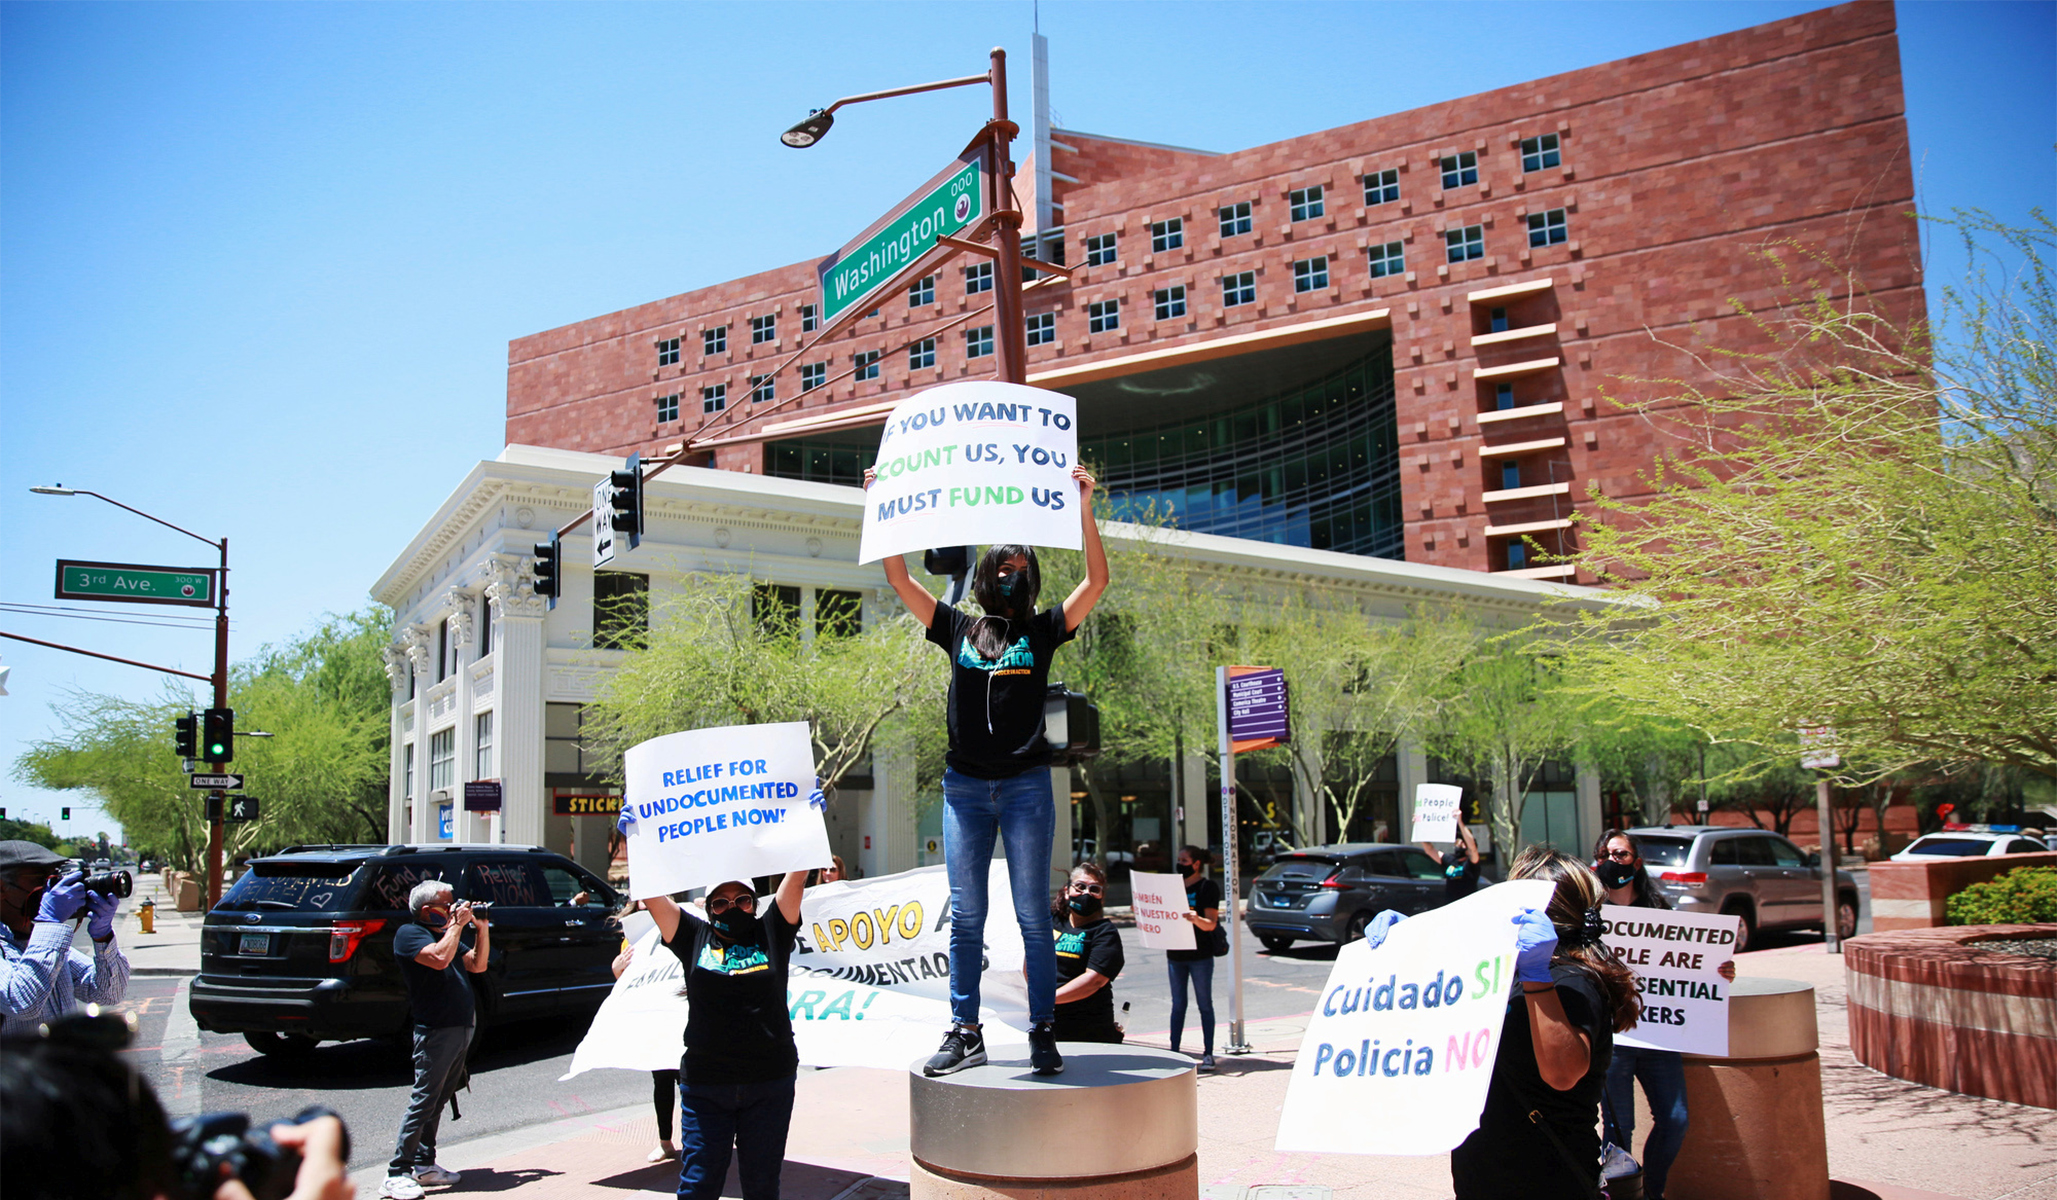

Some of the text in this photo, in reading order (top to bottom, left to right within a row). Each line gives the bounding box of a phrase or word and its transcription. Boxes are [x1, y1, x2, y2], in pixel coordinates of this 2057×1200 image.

[951, 172, 972, 196] 000
[835, 207, 945, 300] Washington
[900, 407, 946, 434] YOU
[953, 402, 1032, 422] WANT
[1038, 407, 1071, 431] TO
[876, 443, 1067, 481] COUNT US, YOU
[597, 483, 612, 511] ONE
[877, 486, 1065, 522] MUST FUND US
[597, 508, 612, 535] WAY
[79, 573, 156, 591] 3rd Ave.
[175, 576, 193, 584] 300
[1251, 688, 1263, 696] Court
[195, 777, 229, 785] ONE WAY
[663, 759, 768, 788] RELIEF FOR
[639, 781, 799, 819] UNDOCUMENTED
[1423, 797, 1454, 809] People
[658, 808, 787, 843] PEOPLE NOW!
[1422, 813, 1450, 822] Police!
[1230, 797, 1238, 895] INFORMATION
[376, 865, 417, 899] Fund
[477, 863, 527, 885] Relief
[492, 884, 535, 906] NOW
[813, 900, 924, 953] APOYO
[1141, 908, 1179, 920] NUESTRO
[727, 951, 769, 972] ACTION
[1609, 946, 1704, 970] PLE ARE
[1323, 969, 1463, 1017] Cuidado
[1636, 977, 1723, 1001] SENTIAL
[787, 990, 880, 1020] RA!
[1638, 1005, 1686, 1026] KERS
[1313, 1039, 1434, 1077] Policia
